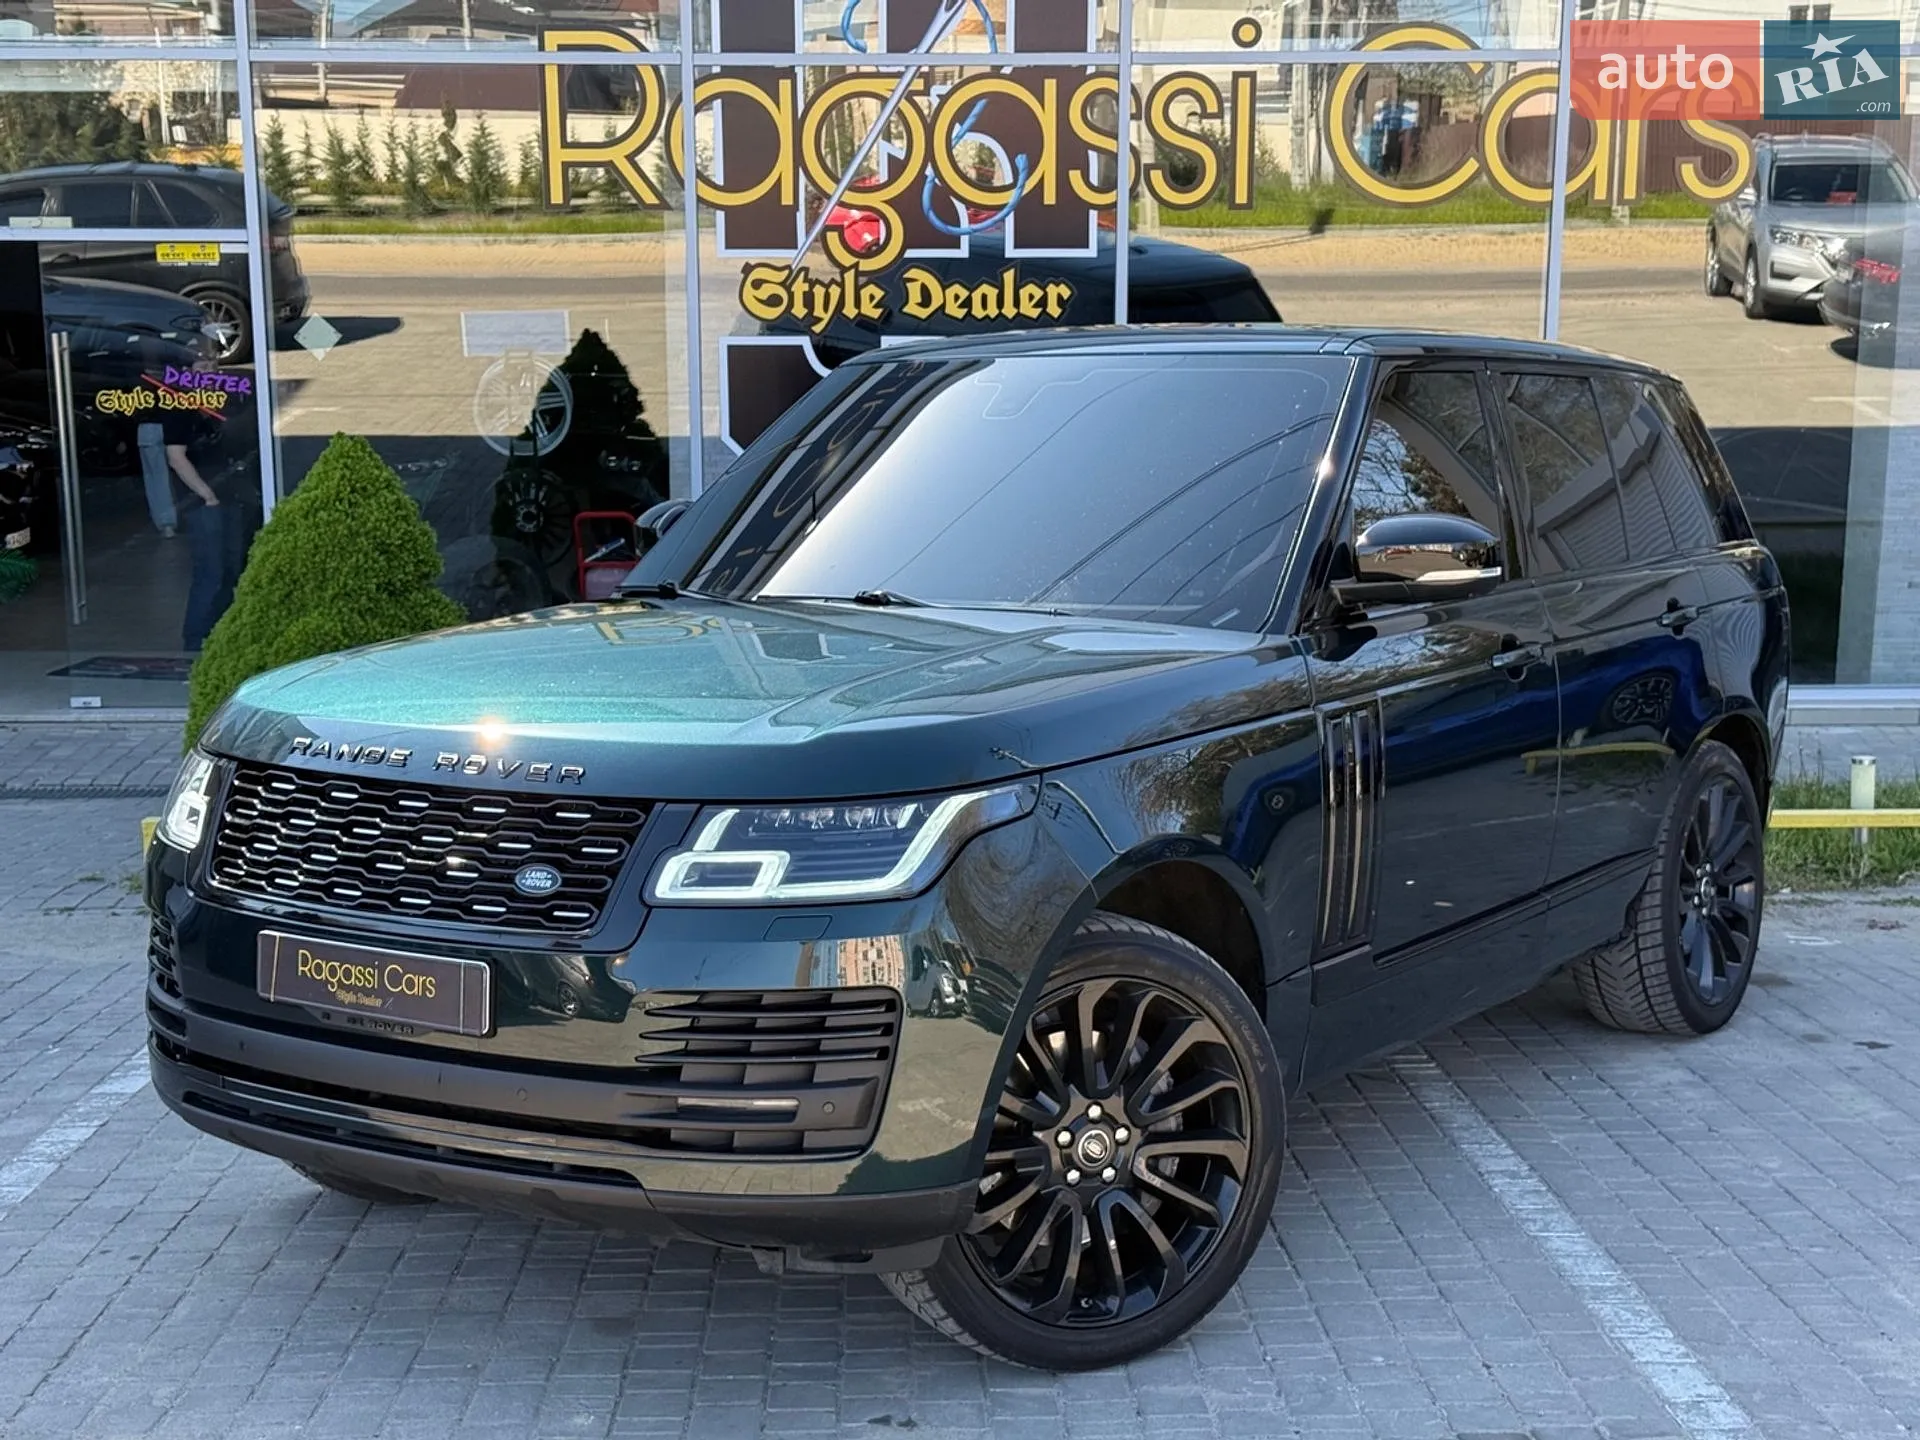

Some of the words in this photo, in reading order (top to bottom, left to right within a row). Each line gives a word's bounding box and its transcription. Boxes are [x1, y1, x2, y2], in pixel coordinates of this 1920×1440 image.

[540, 19, 1258, 273] Ragassi
[1325, 24, 1755, 205] Cars
[740, 263, 887, 335] Style
[901, 266, 1073, 321] Dealer
[96, 385, 154, 416] Style
[157, 387, 228, 411] Dealer
[164, 365, 252, 394] DRIFTER
[289, 737, 413, 768] RANGE
[432, 751, 586, 785] ROVER
[297, 949, 379, 992] Ragassi
[384, 964, 437, 998] Cars
